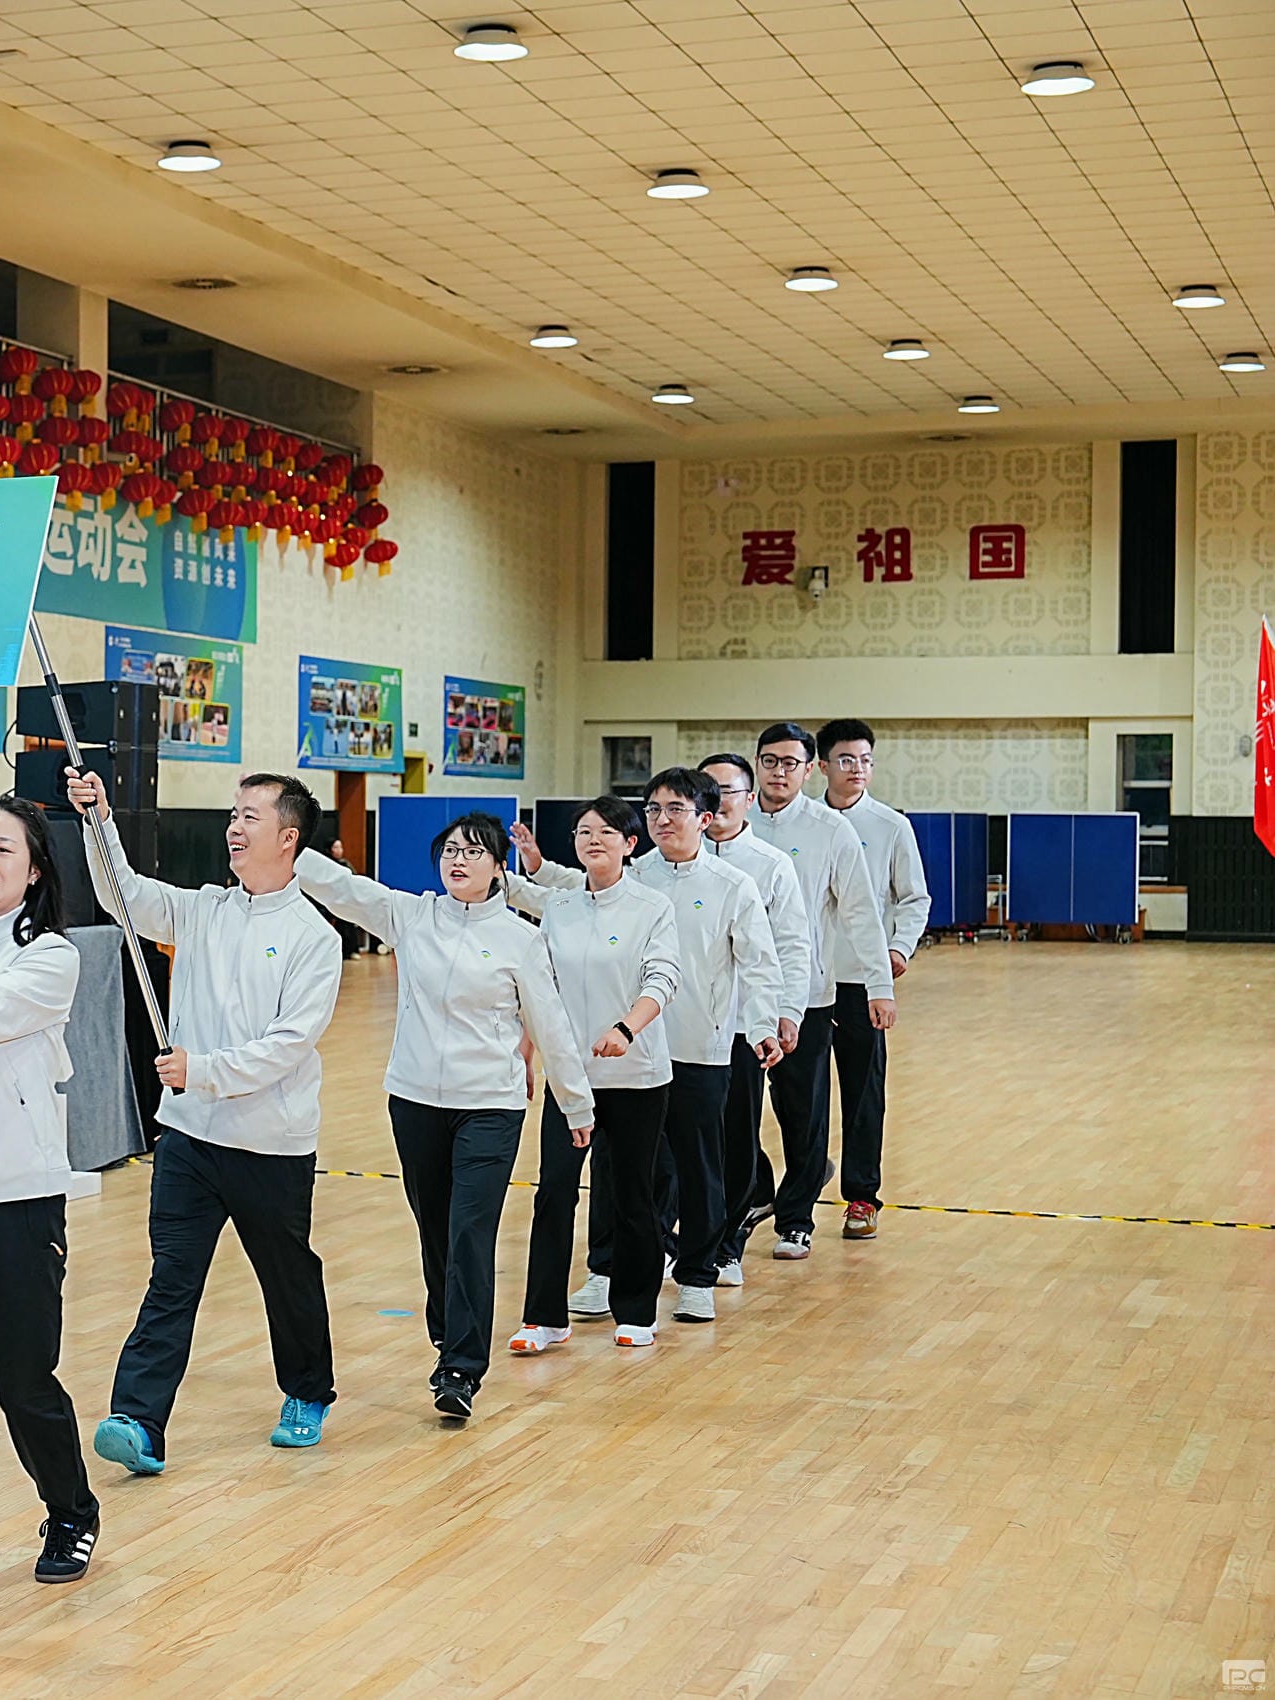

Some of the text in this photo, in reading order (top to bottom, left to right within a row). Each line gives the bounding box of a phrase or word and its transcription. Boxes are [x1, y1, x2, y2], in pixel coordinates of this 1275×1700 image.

[43, 493, 149, 588] 运动会
[741, 524, 1026, 586] 爱祖国
